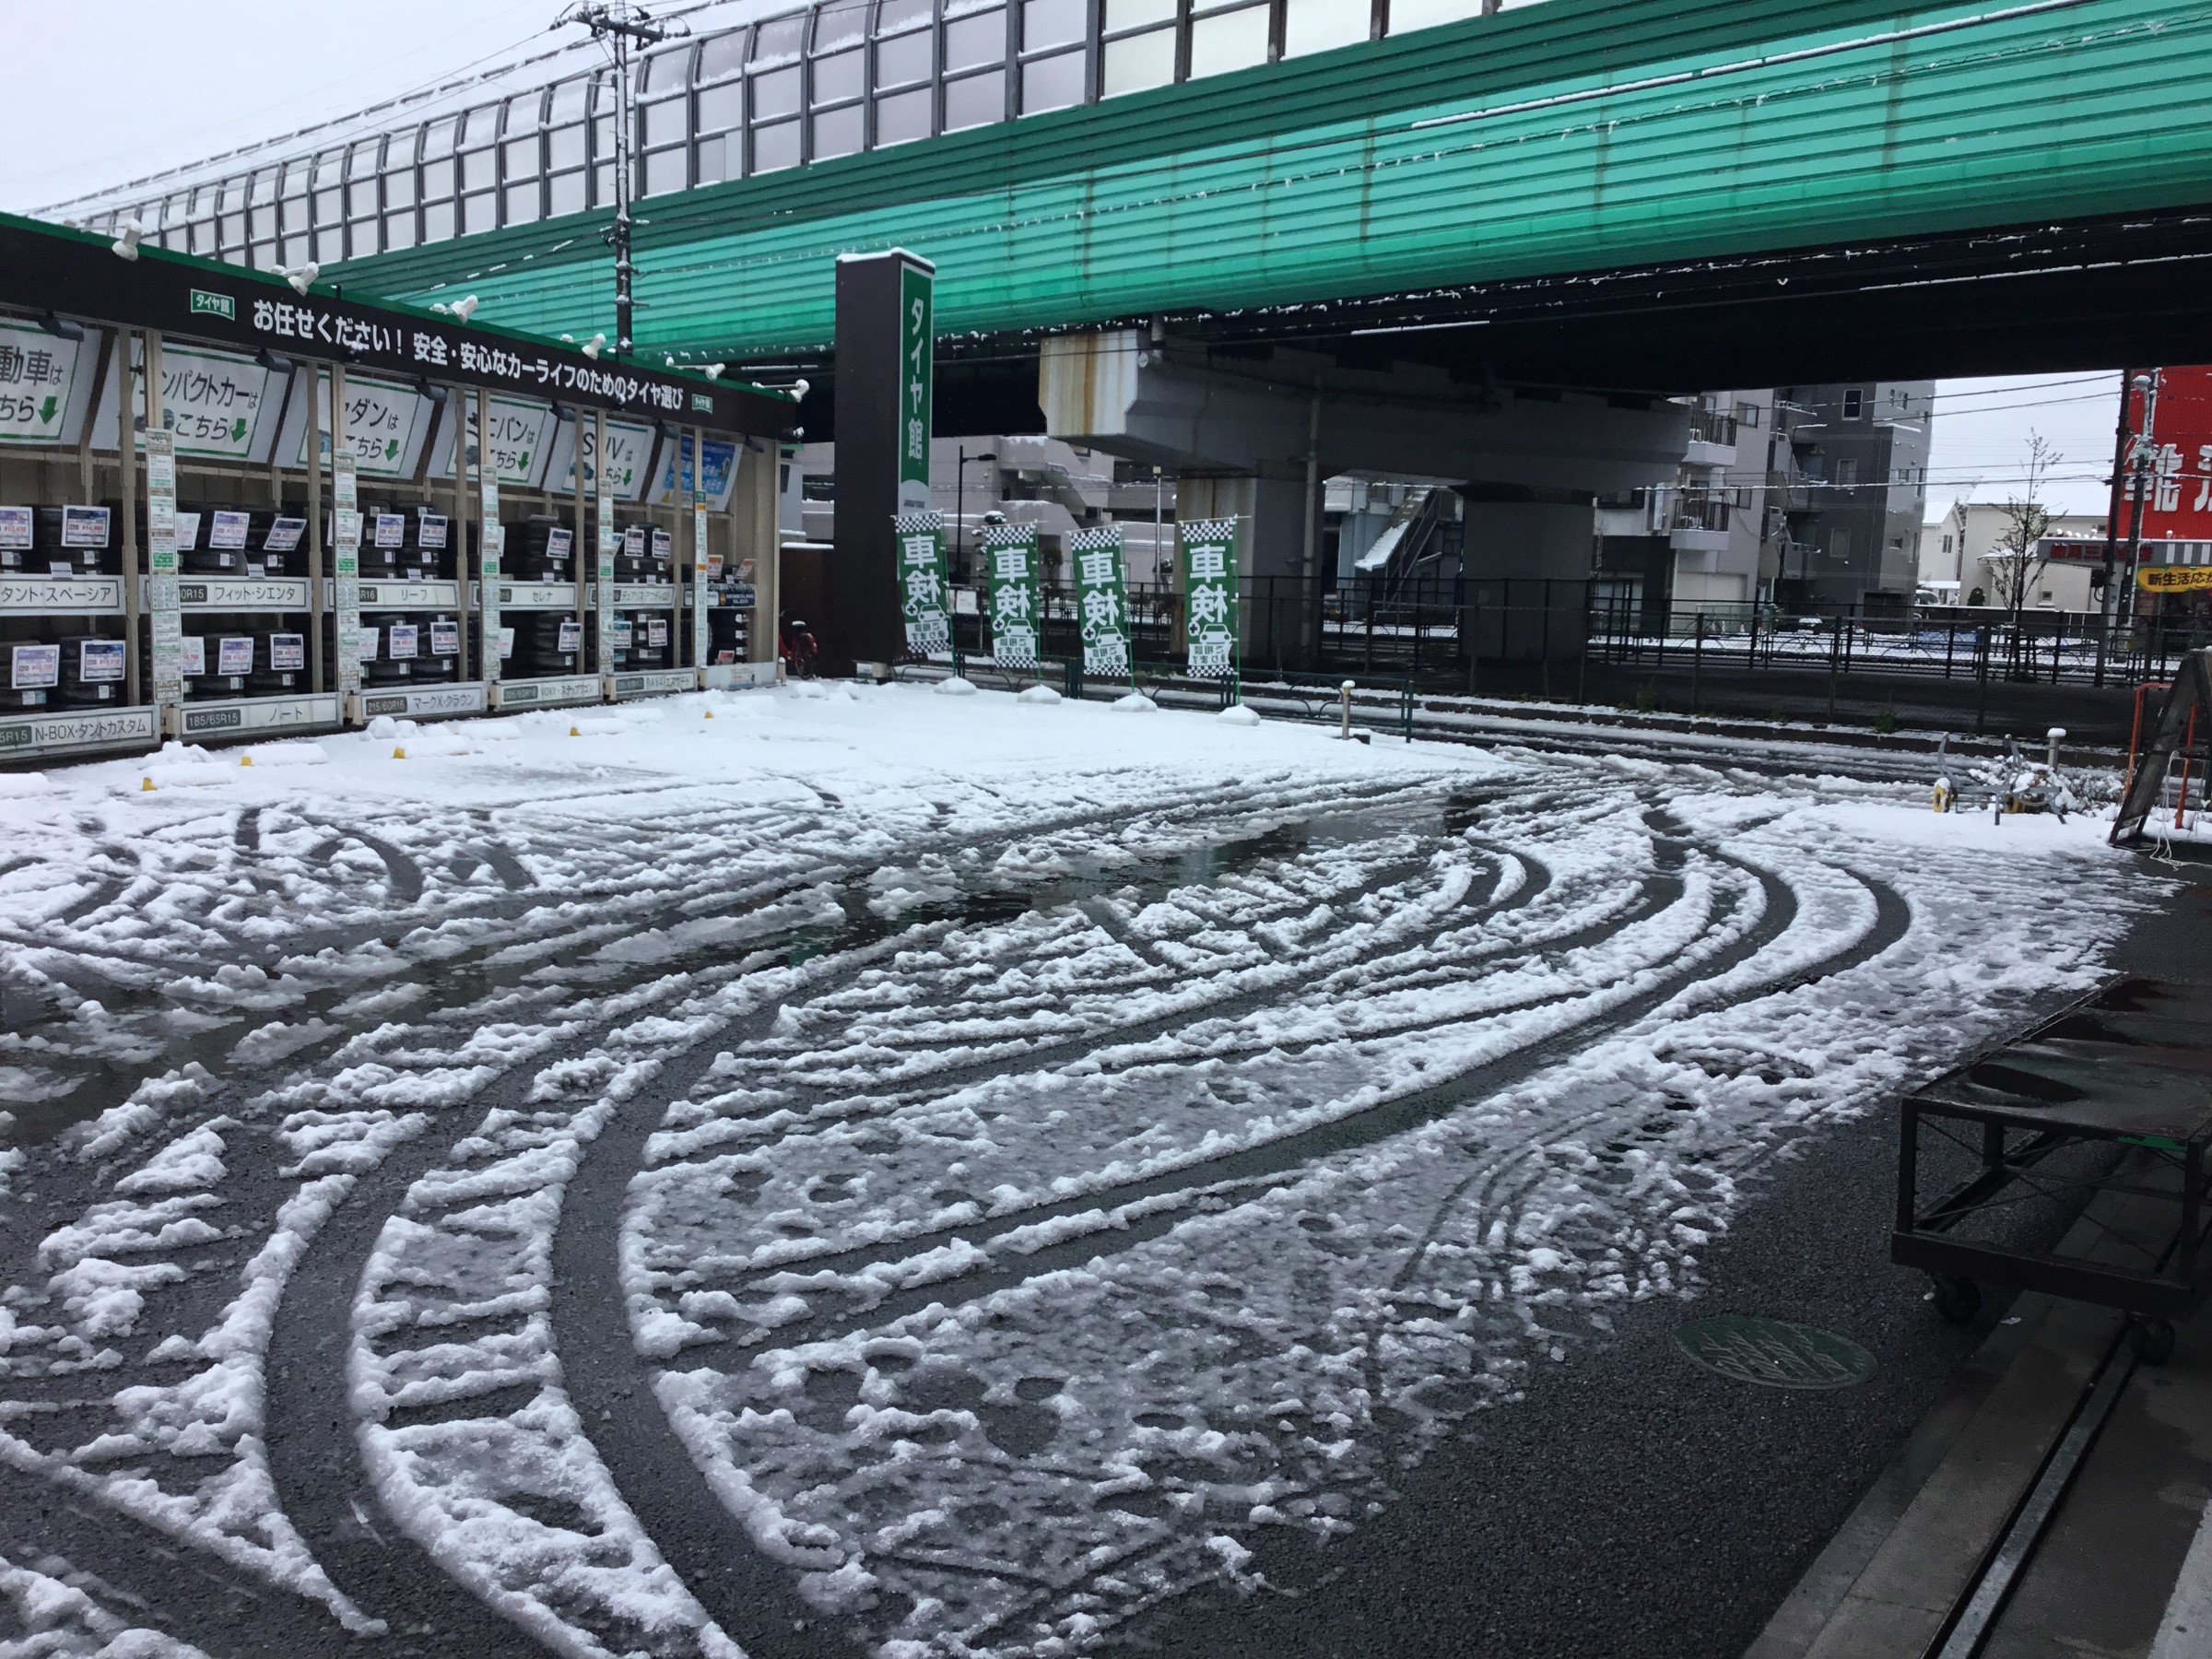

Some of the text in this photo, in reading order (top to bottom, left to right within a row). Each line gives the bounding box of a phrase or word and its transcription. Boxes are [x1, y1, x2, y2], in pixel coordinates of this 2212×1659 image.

[195, 294, 230, 314] タイヤ館
[139, 370, 258, 409] ンパクトカーは
[910, 298, 924, 459] タイヤ館
[346, 398, 399, 430] ダンは
[176, 413, 229, 441] こちら
[2, 586, 112, 603] タント・スペーシア
[215, 586, 296, 601] フィット・シエンタ
[188, 706, 302, 727] 185/65R15 ノート
